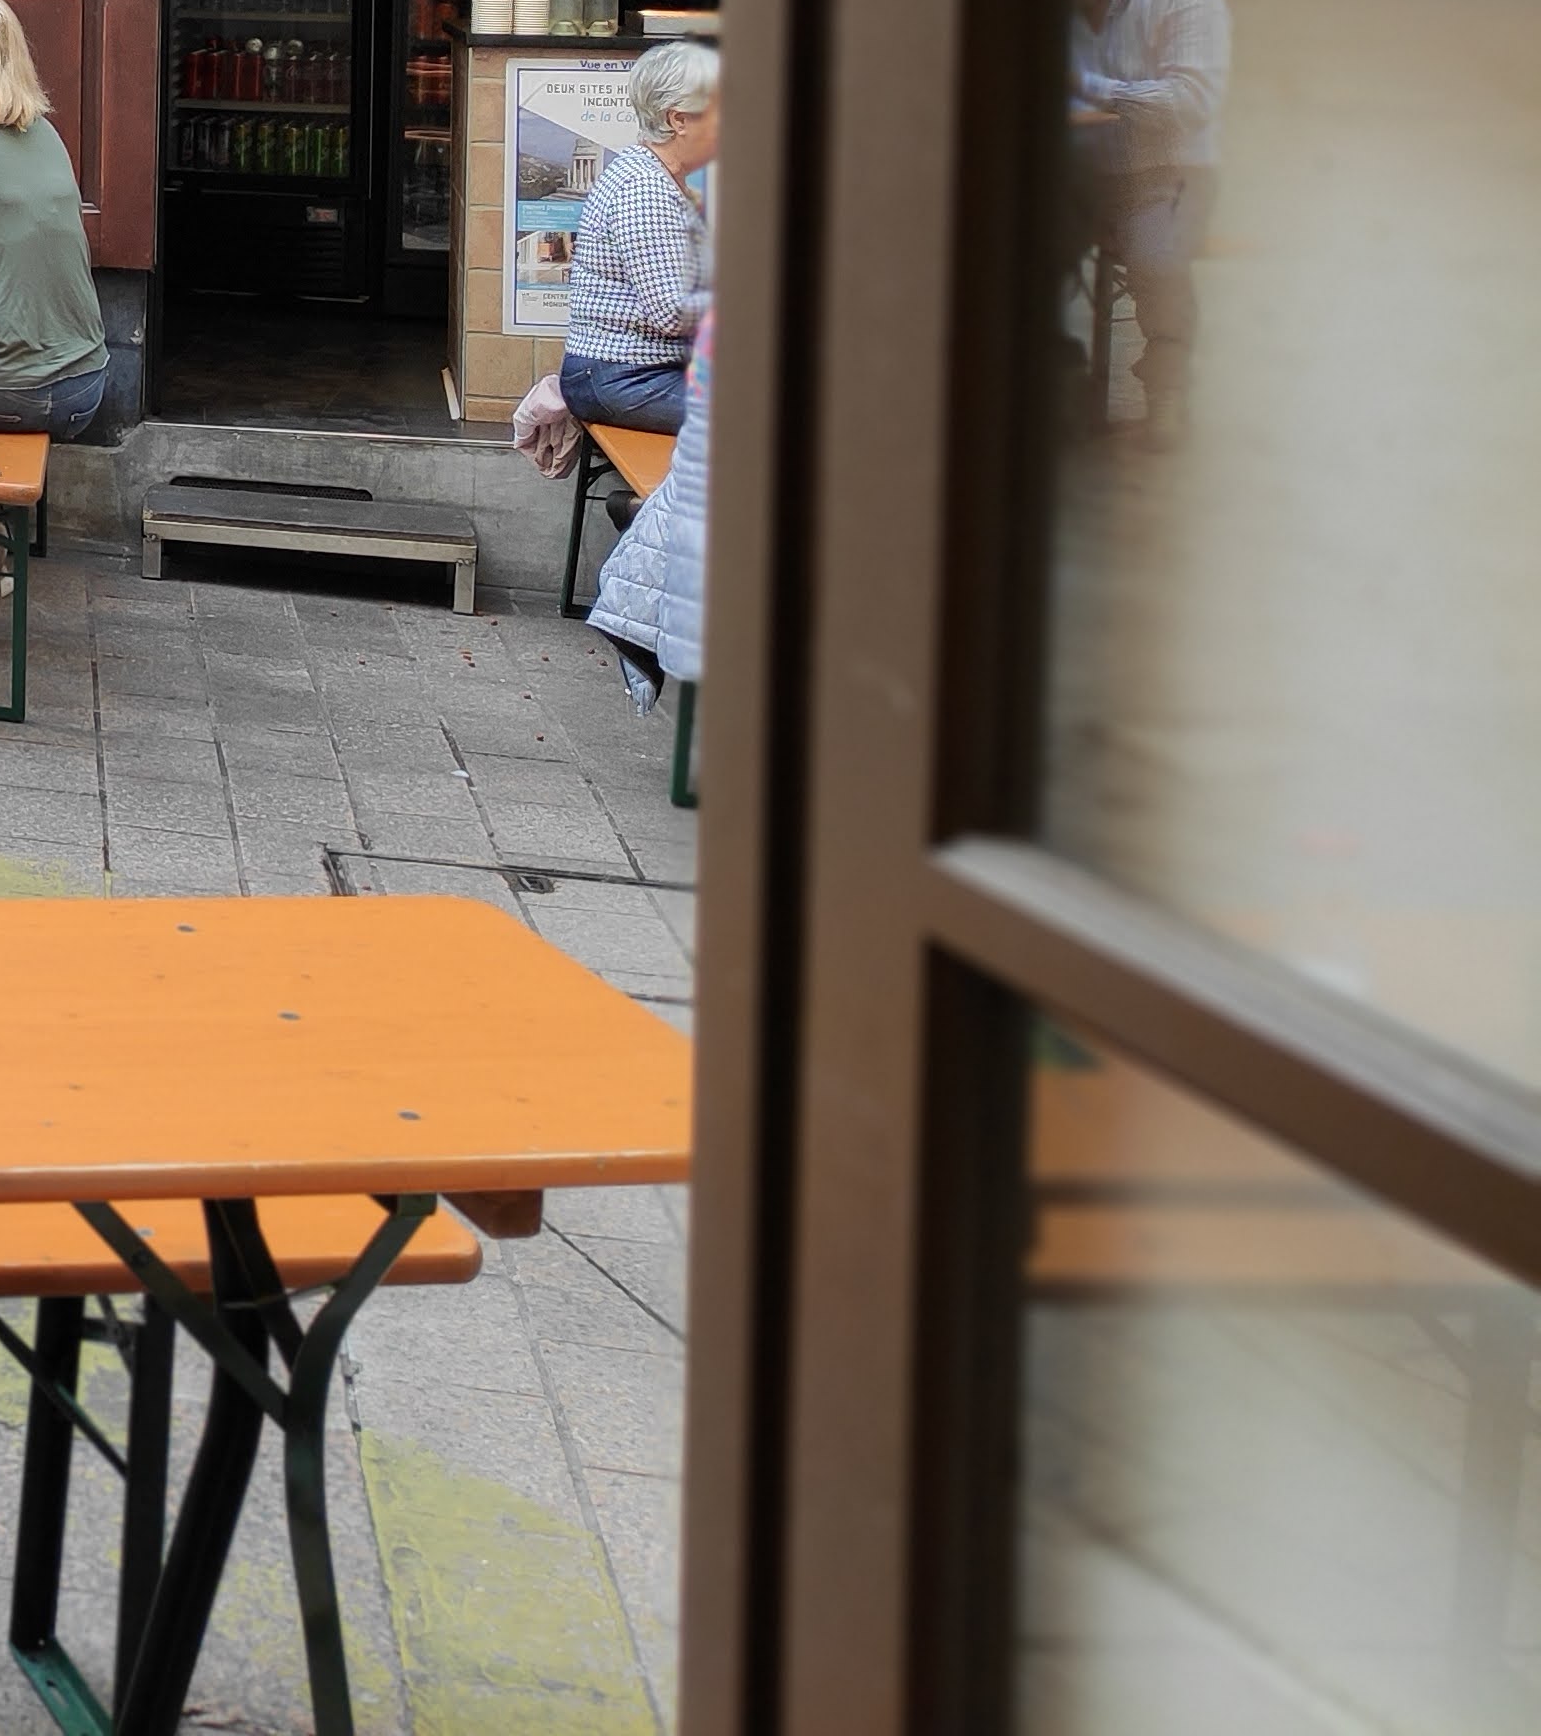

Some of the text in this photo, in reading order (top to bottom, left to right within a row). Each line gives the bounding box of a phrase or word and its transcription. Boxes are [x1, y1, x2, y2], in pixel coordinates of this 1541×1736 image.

[580, 60, 601, 69] Vue
[546, 83, 628, 94] DEUX SITES HI
[581, 110, 596, 122] de
[600, 110, 611, 122] la
